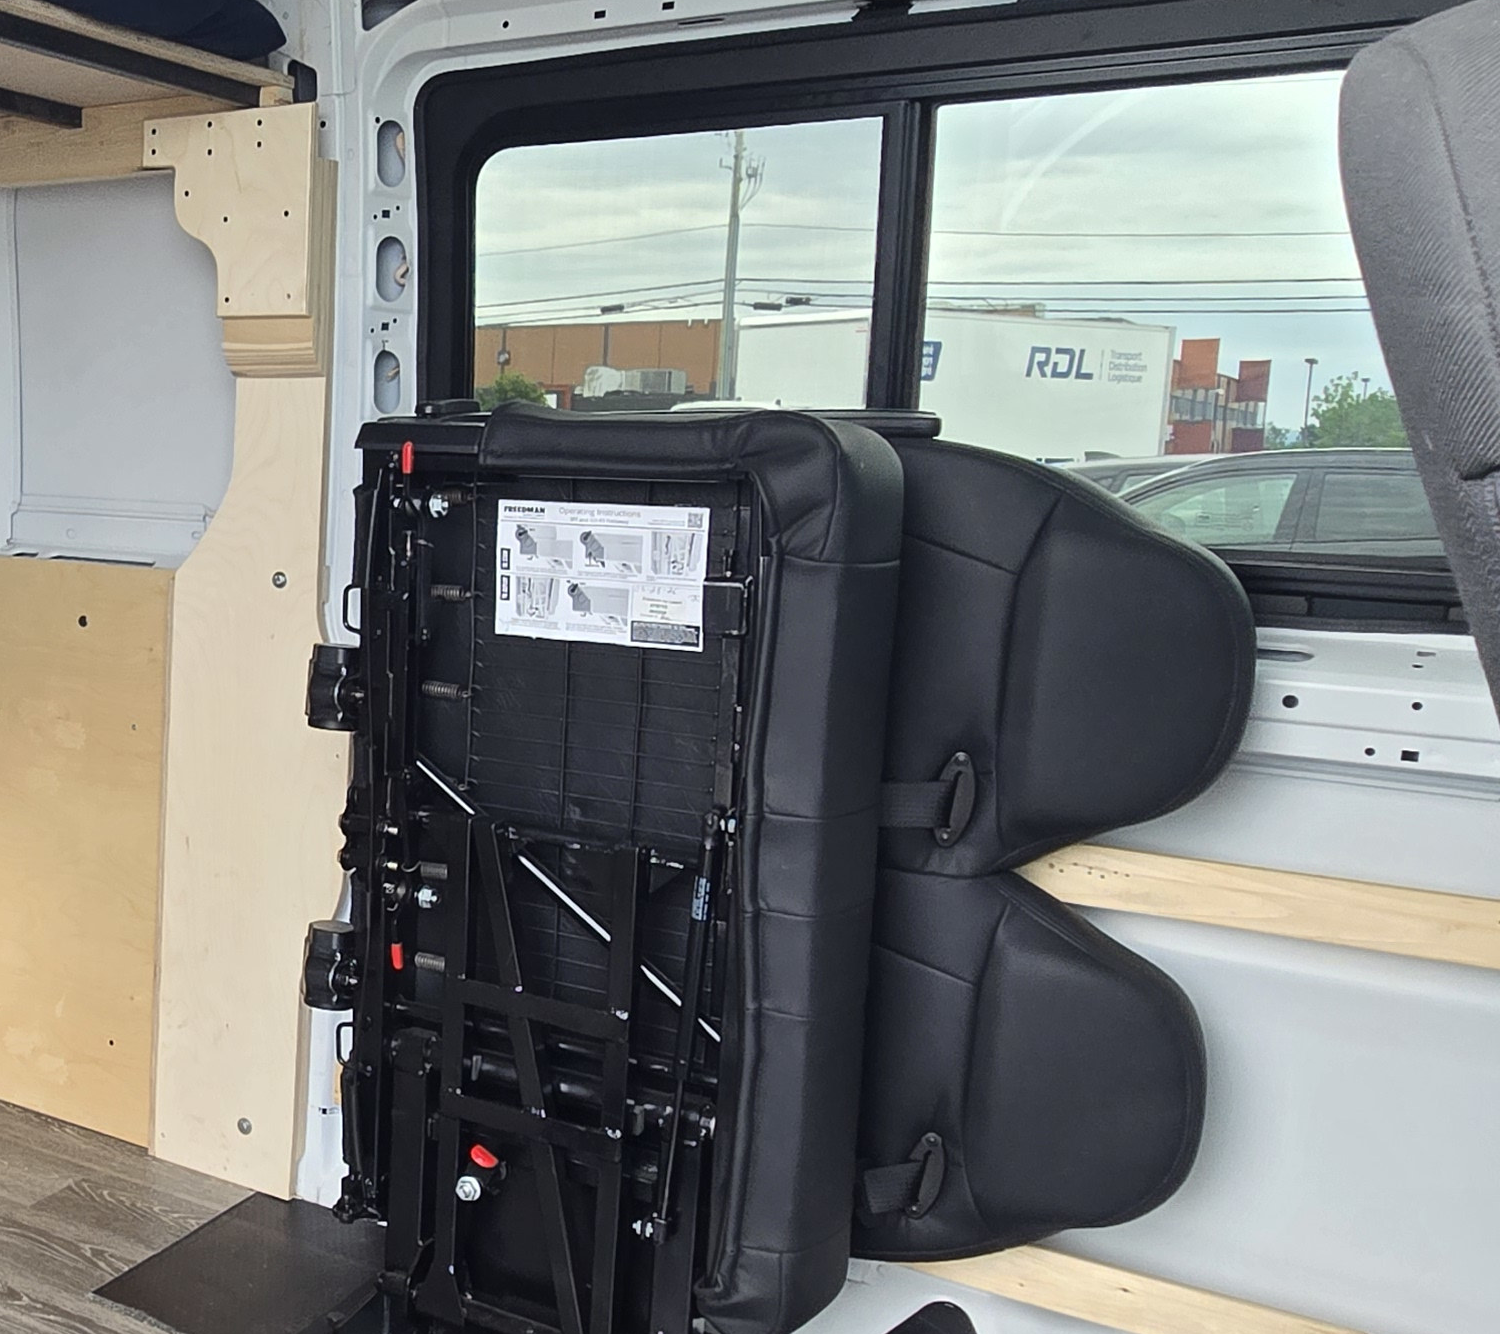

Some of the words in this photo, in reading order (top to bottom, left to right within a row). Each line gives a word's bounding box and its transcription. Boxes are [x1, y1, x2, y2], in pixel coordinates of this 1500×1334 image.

[1110, 350, 1143, 361] Transport
[1025, 346, 1094, 380] RDL
[1108, 361, 1148, 372] Distribution
[1107, 372, 1143, 384] Logistique
[503, 505, 546, 514] FREEDMAN
[559, 506, 595, 517] Operating
[596, 508, 642, 518] Instructions
